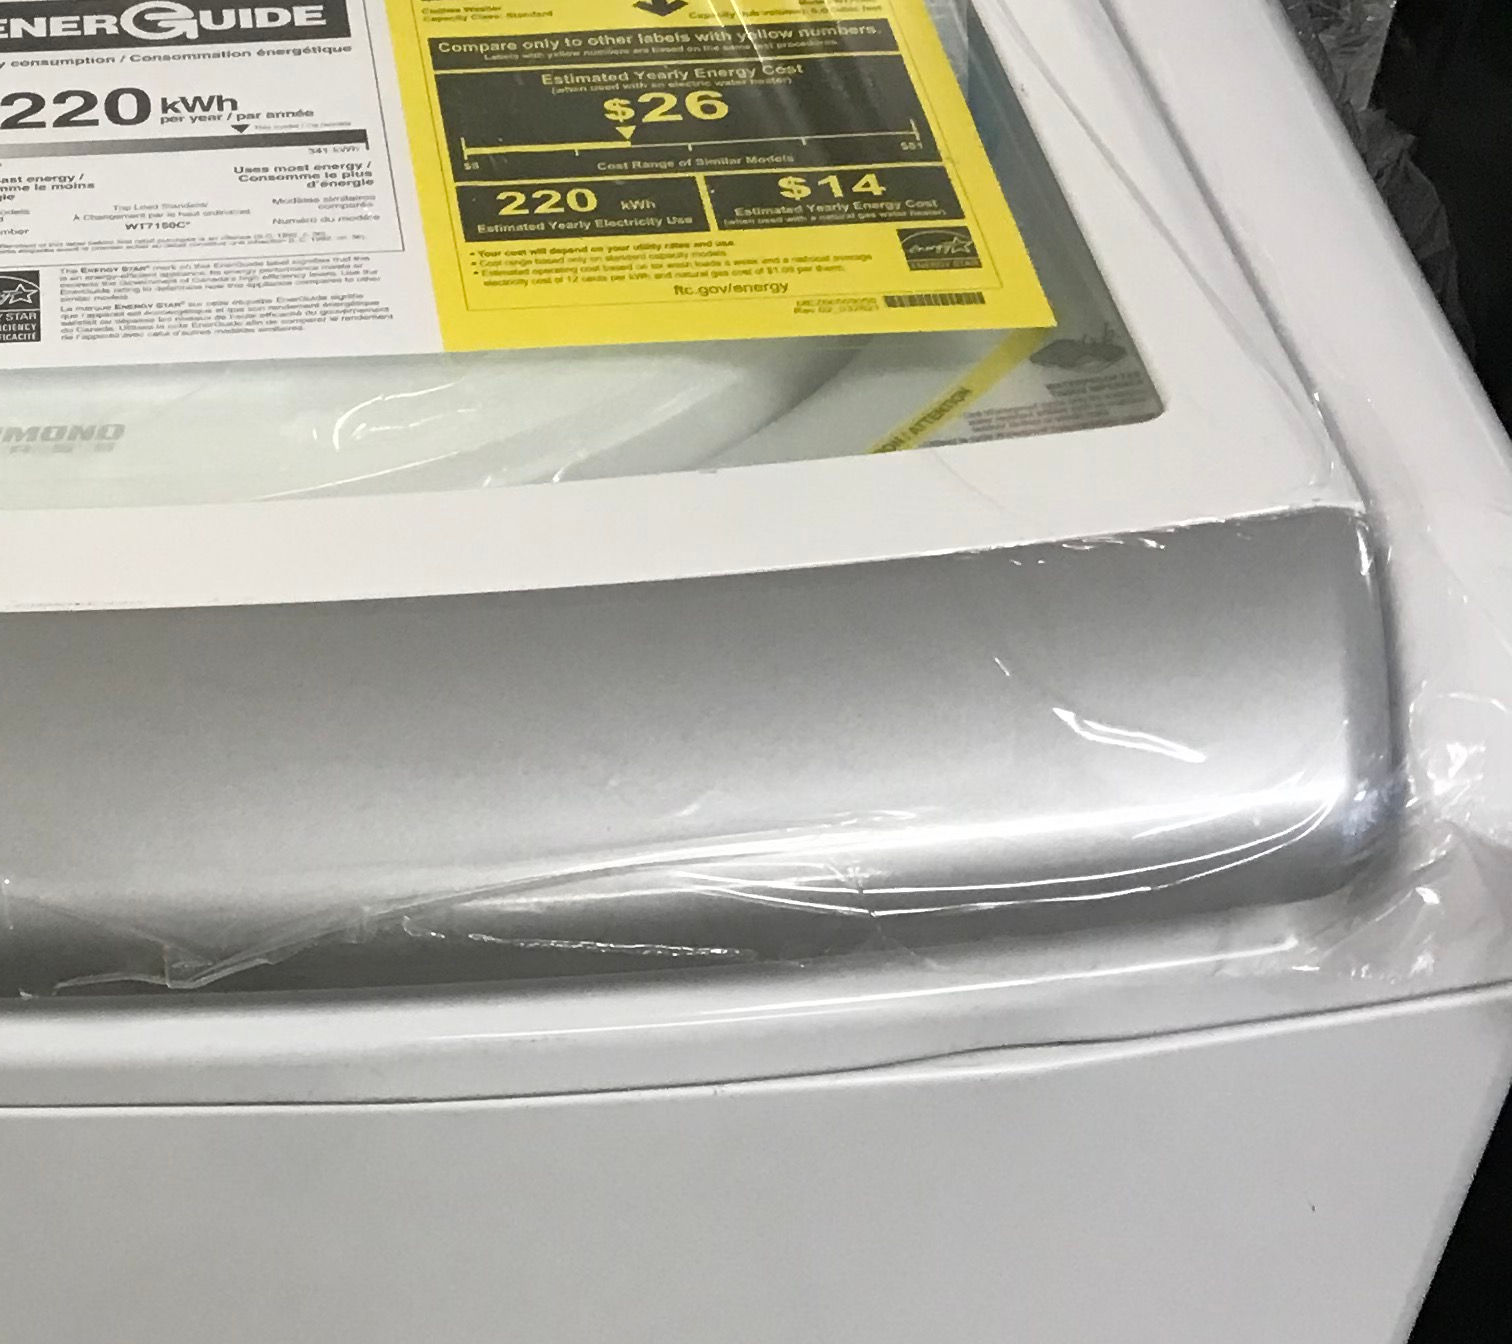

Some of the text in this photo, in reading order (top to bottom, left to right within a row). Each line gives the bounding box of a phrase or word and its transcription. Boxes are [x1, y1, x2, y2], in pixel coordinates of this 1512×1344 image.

[438, 25, 878, 54] Compare only to other labels with yellow numbers.
[10, 56, 116, 67] consumption
[130, 50, 252, 63] Consommation
[256, 45, 353, 57] énergétique
[541, 63, 804, 85] Estimated Yearly Energy Cost
[0, 87, 152, 130] 220
[160, 94, 239, 114] kWh
[602, 90, 730, 124] $26
[159, 108, 315, 125] per year par année
[233, 162, 363, 174] Uses most energy
[596, 154, 795, 171] Cost Range of Similar Models
[26, 174, 76, 184] energy
[238, 170, 373, 183] Consomme le plus
[34, 183, 47, 191] le
[51, 182, 95, 191] moins
[777, 172, 887, 201] $14
[495, 187, 656, 216] 220 kWh
[734, 198, 938, 217] Estimated Yearly Energy Cost
[477, 216, 693, 234] Estimated Yearly Electricity Use
[477, 250, 502, 258] Your
[549, 246, 588, 256] depend
[606, 244, 630, 254] your
[672, 281, 790, 298] ftc.gov/energy
[5, 311, 37, 322] STAR
[908, 386, 973, 435] ATTENTION
